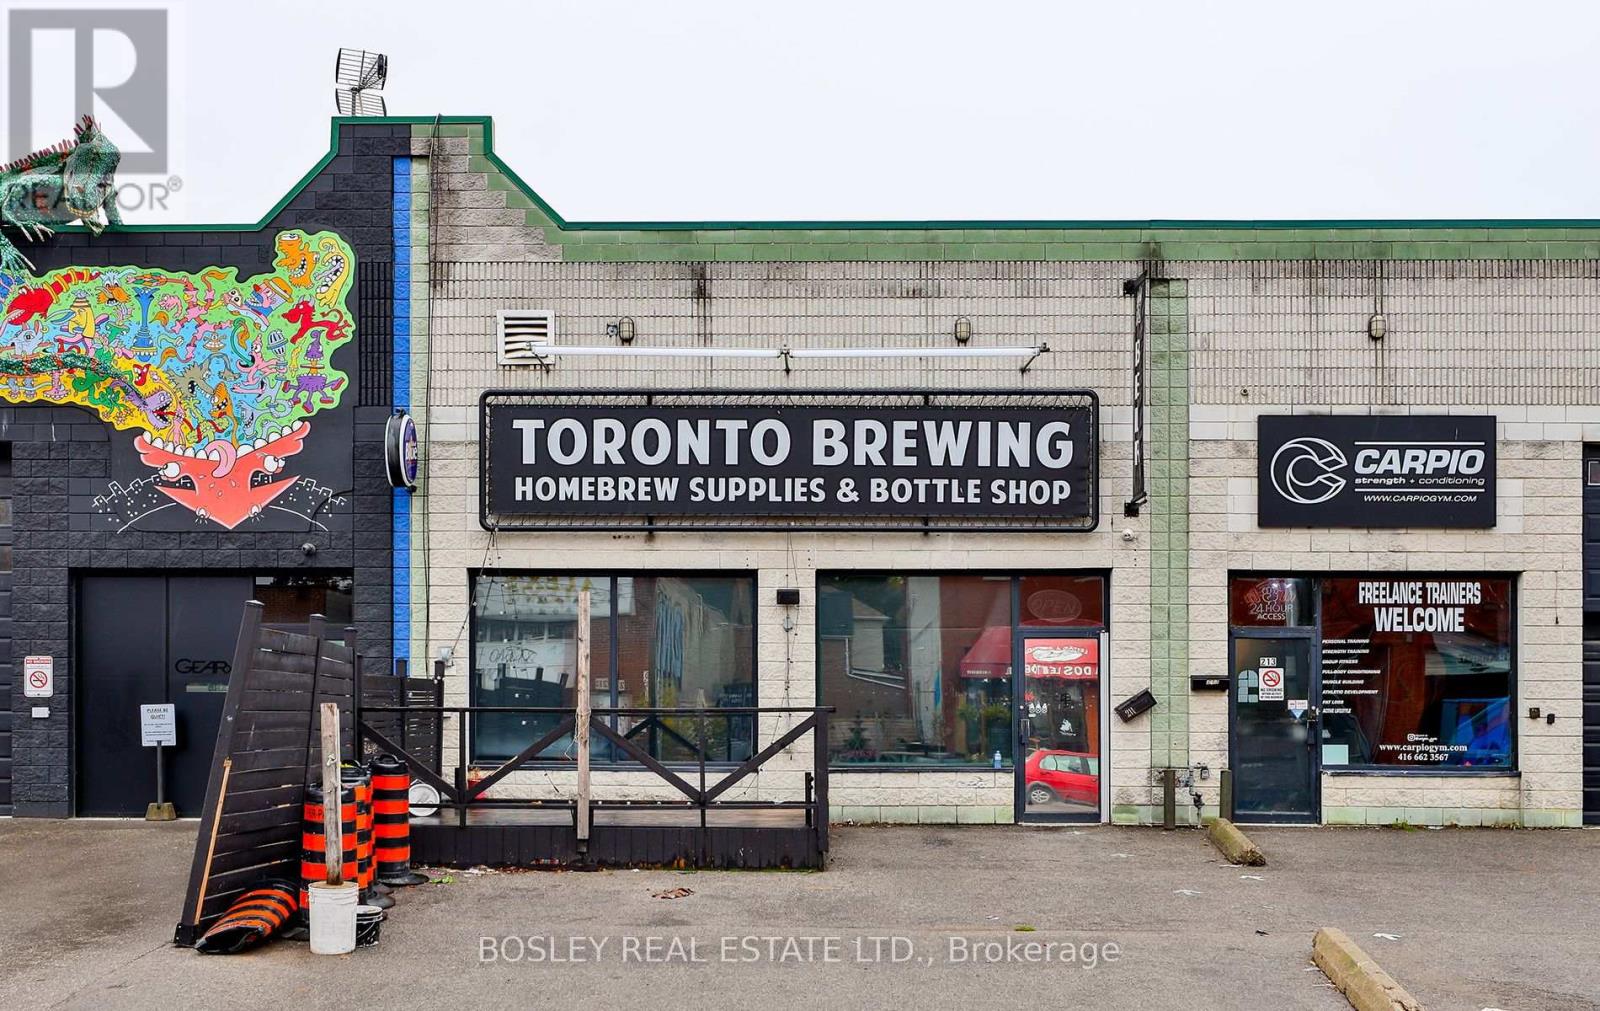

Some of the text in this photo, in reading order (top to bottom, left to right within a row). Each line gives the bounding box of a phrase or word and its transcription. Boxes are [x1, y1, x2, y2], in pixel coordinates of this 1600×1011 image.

[512, 419, 1074, 468] TORONTO BREWING
[1354, 449, 1485, 475] CARPIO
[1354, 476, 1406, 486] strength
[1418, 476, 1485, 486] conditioning
[514, 476, 1072, 506] HOMEBREW SUPPLIES & BOTTLE SHOP
[1364, 494, 1477, 502] WWW.CARPIOGYM.COM
[1358, 581, 1481, 604] FREELANCE TRAINERS
[1265, 603, 1294, 613] HOUR
[1374, 607, 1465, 632] WELCOME
[1260, 657, 1276, 667] 213
[1379, 743, 1468, 753] www.carpiogym.com
[1397, 753, 1449, 761] 416 662 3567
